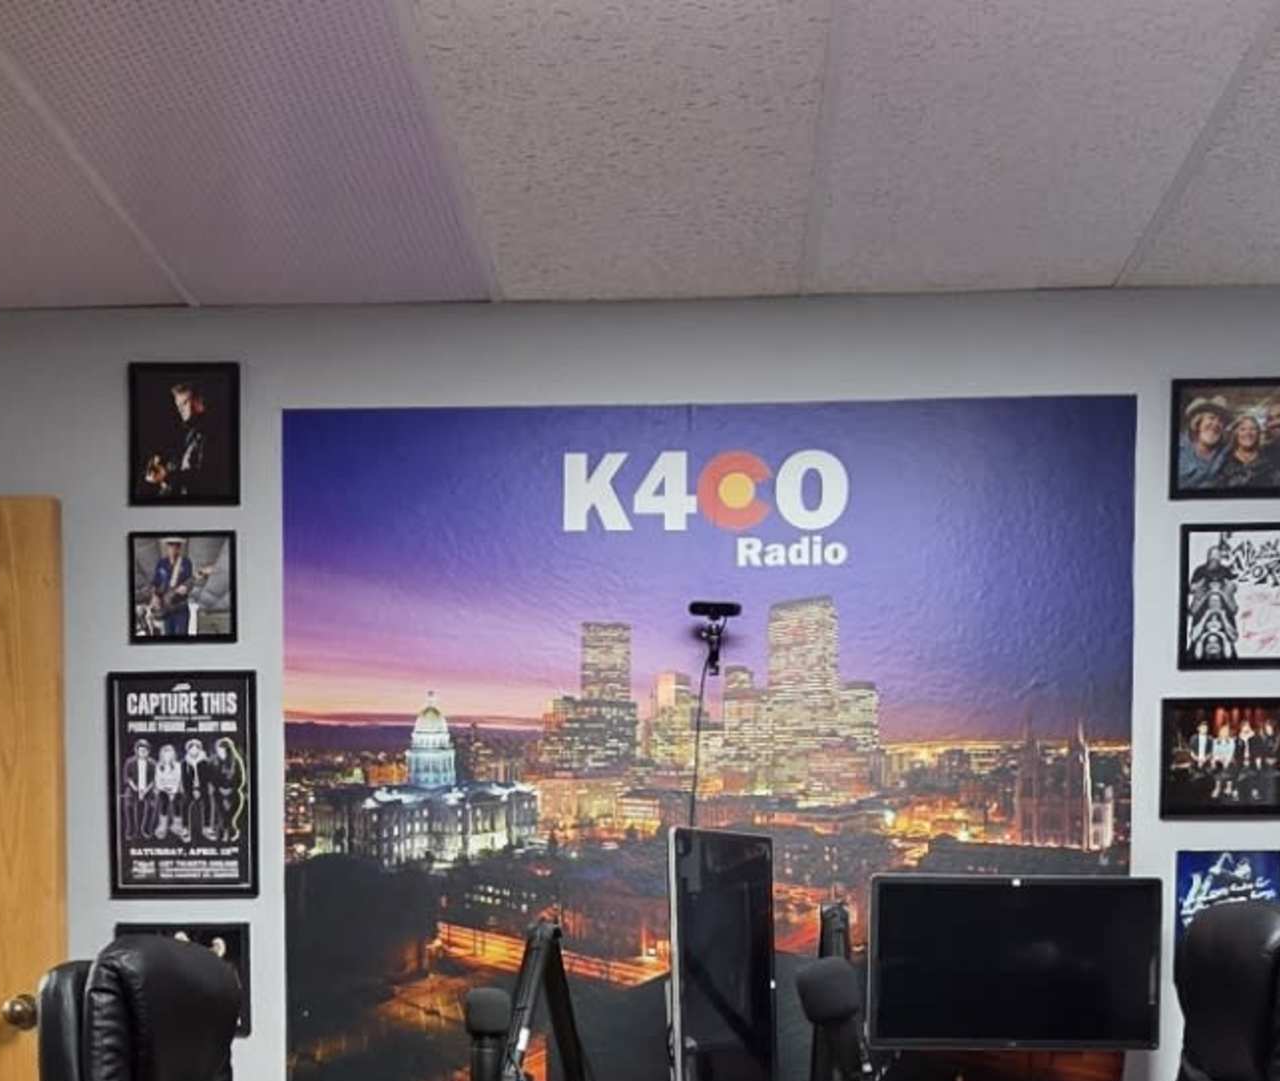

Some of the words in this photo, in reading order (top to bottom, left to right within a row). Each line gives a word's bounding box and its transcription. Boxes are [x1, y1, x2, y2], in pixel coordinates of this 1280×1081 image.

[563, 449, 849, 532] K4CO
[736, 536, 849, 568] Radio
[126, 692, 198, 715] CAPTURE
[200, 692, 238, 715] THIS
